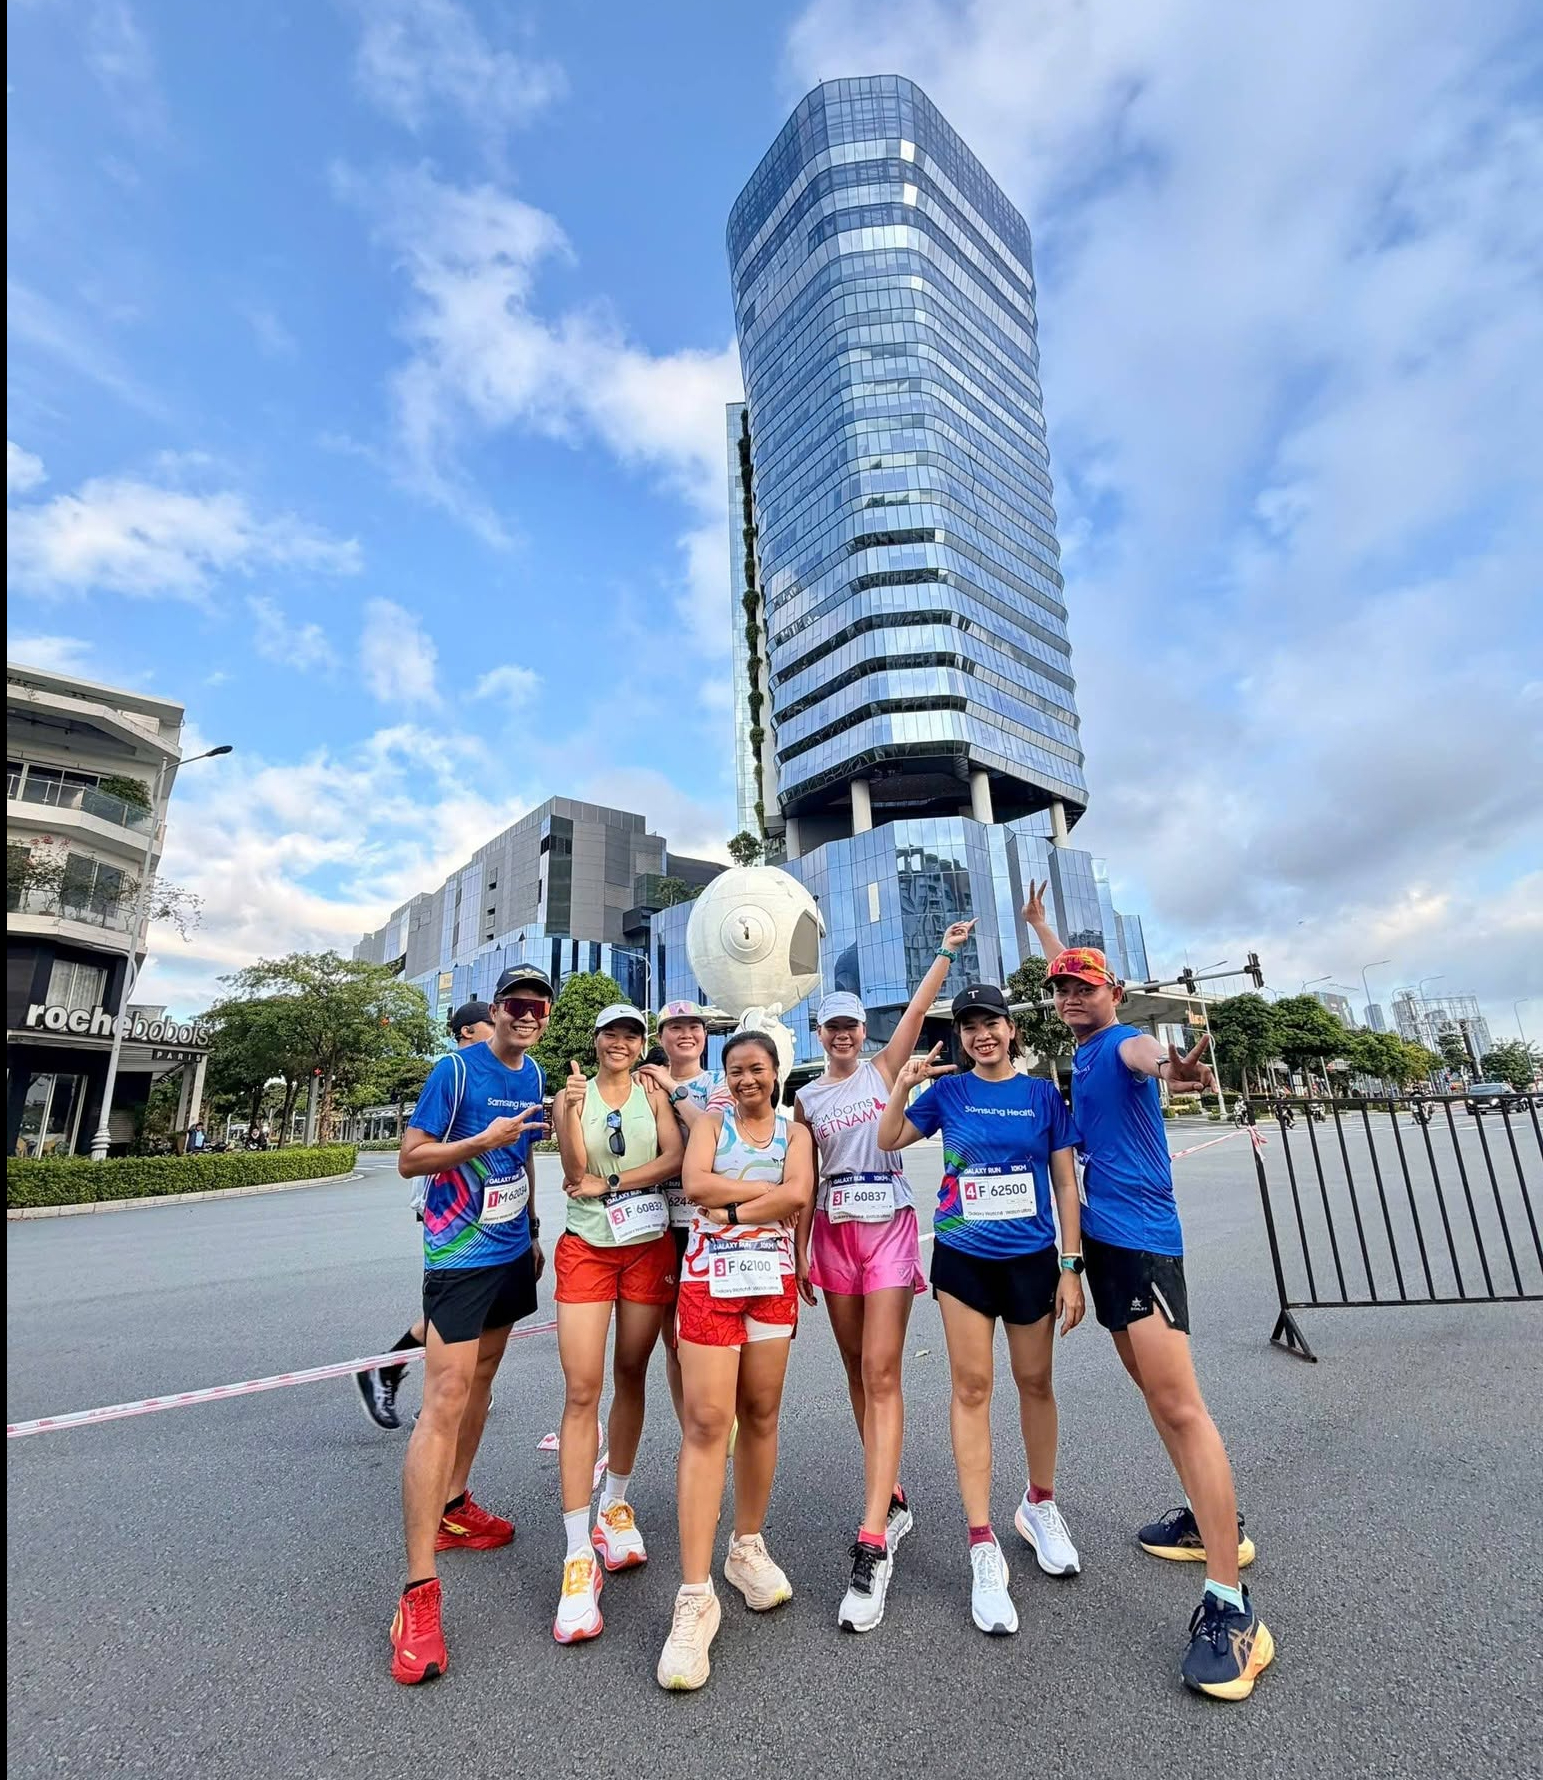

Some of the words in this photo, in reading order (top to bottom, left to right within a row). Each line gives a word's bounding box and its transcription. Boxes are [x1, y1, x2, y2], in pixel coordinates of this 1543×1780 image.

[156, 1051, 201, 1062] PARIS
[487, 1097, 519, 1110] Samsung
[964, 1105, 1006, 1117] Samsung
[1006, 1108, 1036, 1118] Health
[963, 1167, 987, 1175] GALAXY
[988, 1166, 1002, 1174] RUN
[498, 1191, 508, 1203] M
[844, 1191, 850, 1203] F
[853, 1191, 887, 1202] 60837
[978, 1185, 986, 1198] F
[990, 1183, 1028, 1197] 62500
[624, 1206, 633, 1218] F
[636, 1201, 664, 1214] 60832
[728, 1260, 736, 1273] F
[739, 1259, 771, 1272] 62100
